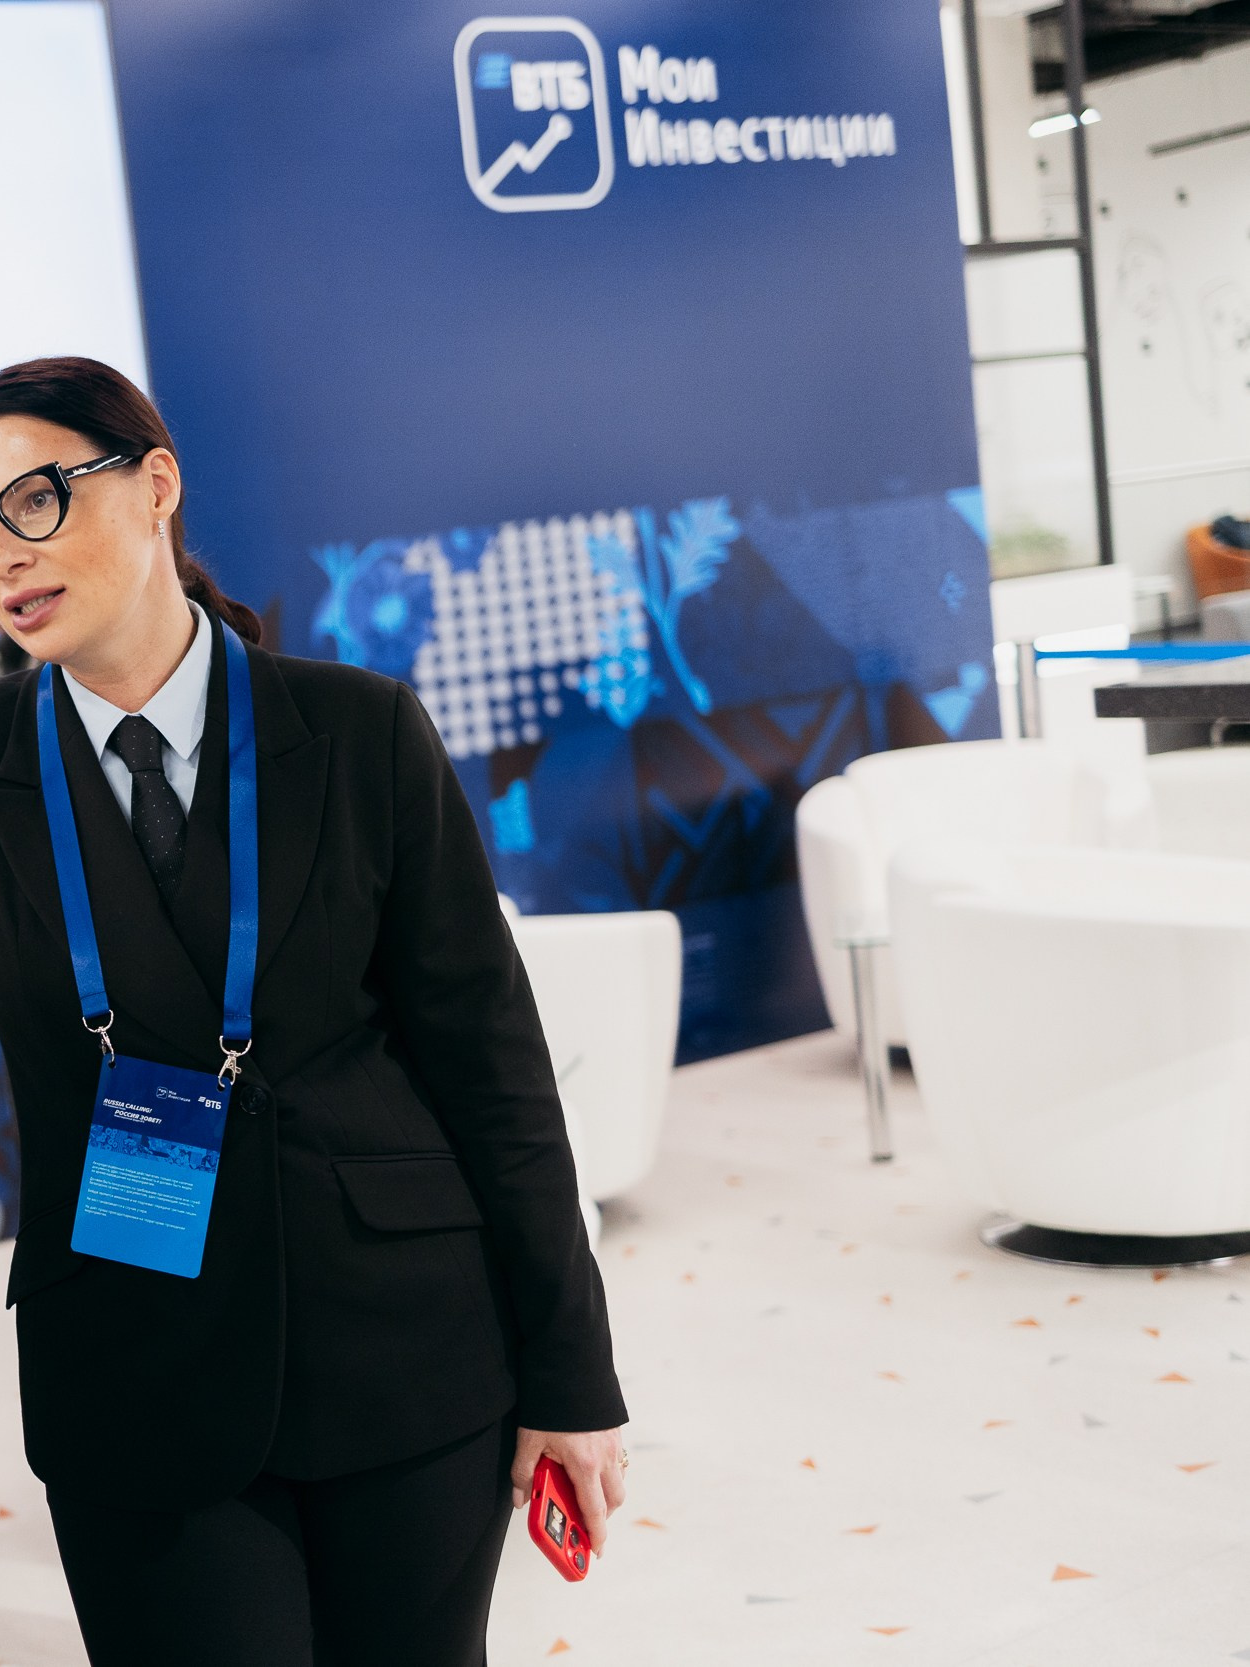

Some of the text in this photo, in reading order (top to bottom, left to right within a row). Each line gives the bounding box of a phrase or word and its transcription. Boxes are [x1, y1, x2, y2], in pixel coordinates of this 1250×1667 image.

[511, 60, 591, 112] ВТБ
[617, 44, 719, 104] Мои
[624, 106, 897, 168] Инвестиции
[103, 1098, 125, 1108] RUSSIA
[125, 1102, 153, 1114] CALLING!
[114, 1109, 140, 1120] РОССИЯ
[139, 1114, 162, 1125] ЗОВЕТ!
[205, 1098, 222, 1110] ВТБ
